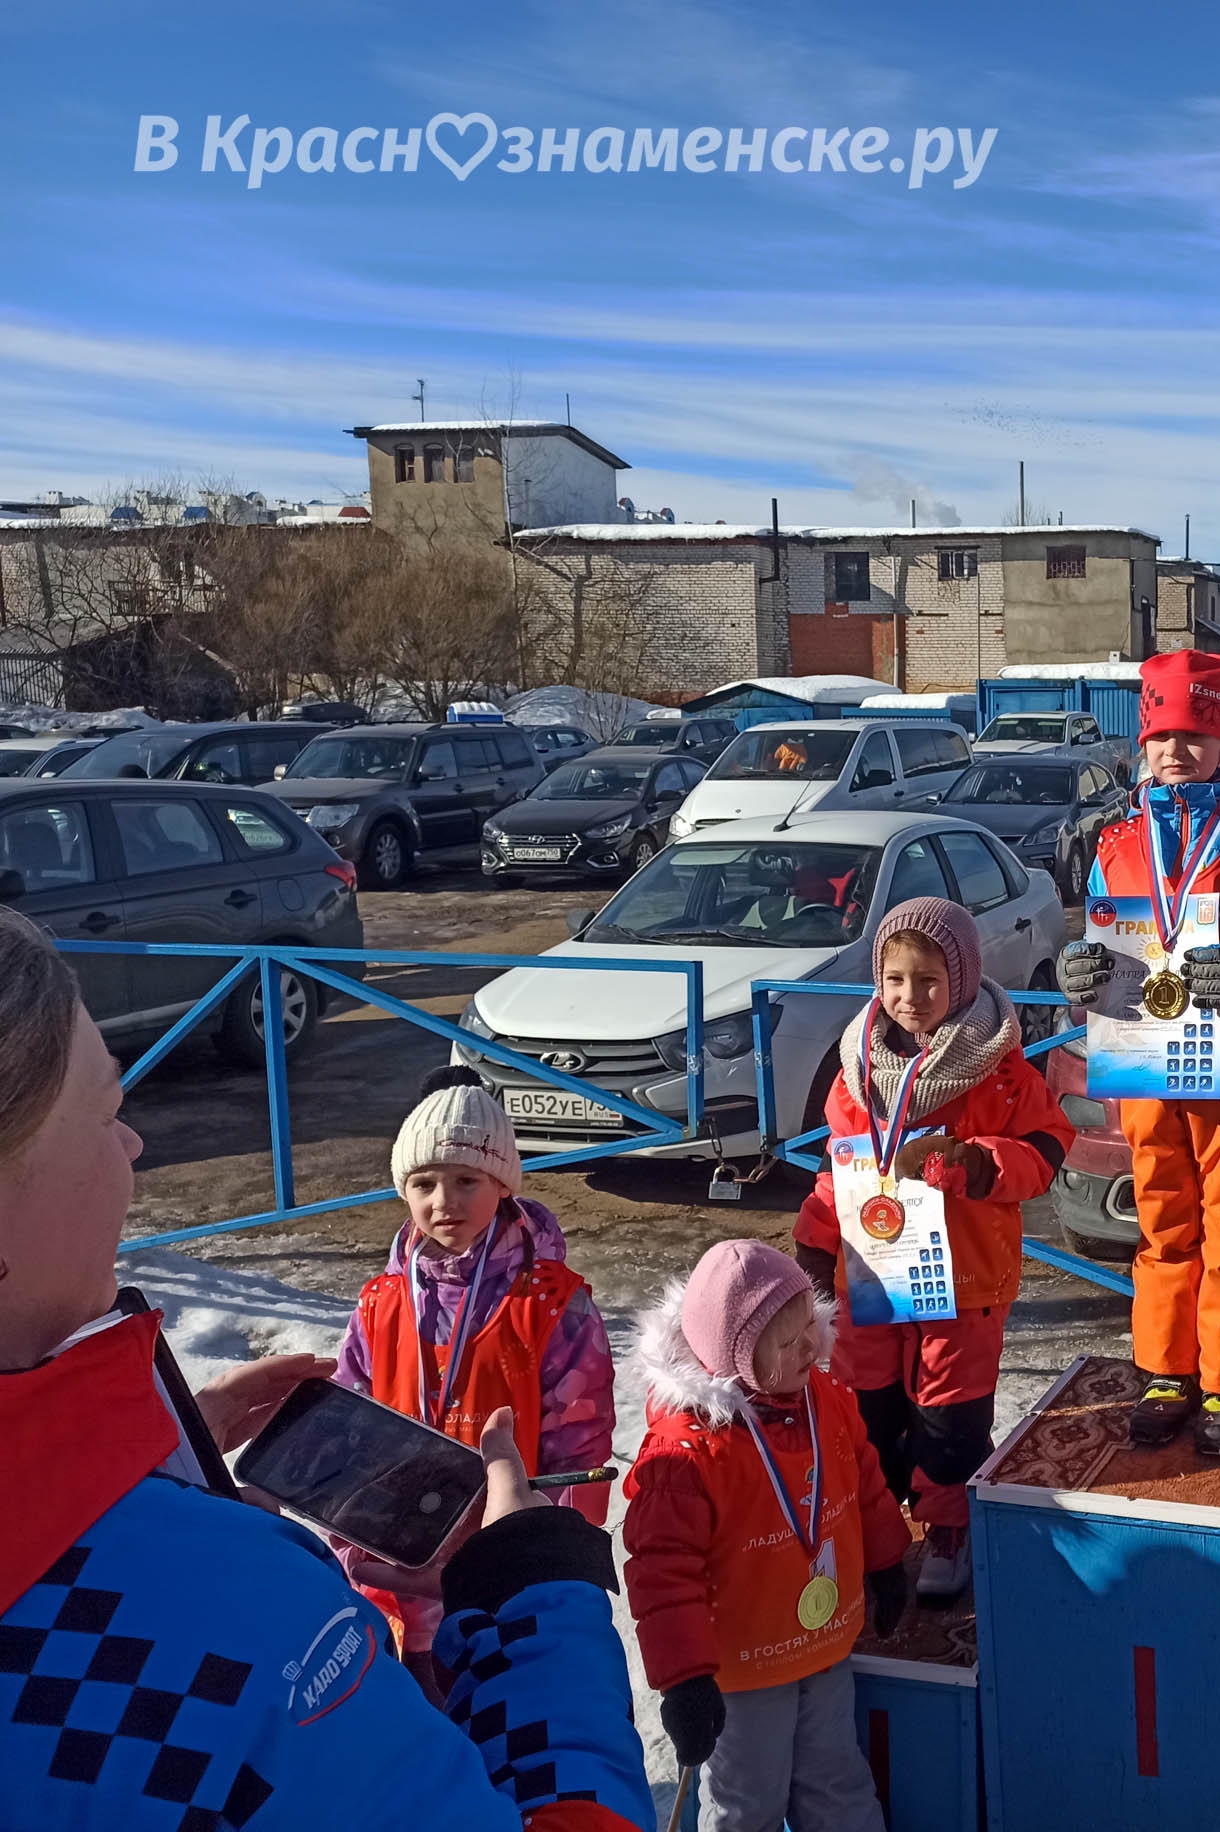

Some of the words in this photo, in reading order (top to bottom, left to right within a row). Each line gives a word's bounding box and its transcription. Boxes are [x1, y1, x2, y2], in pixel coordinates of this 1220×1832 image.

[510, 1094, 583, 1116] Е052УЕ
[332, 1625, 363, 1668] SPORT
[740, 1650, 750, 1661] В
[754, 1632, 810, 1659] ГОСТЯХ
